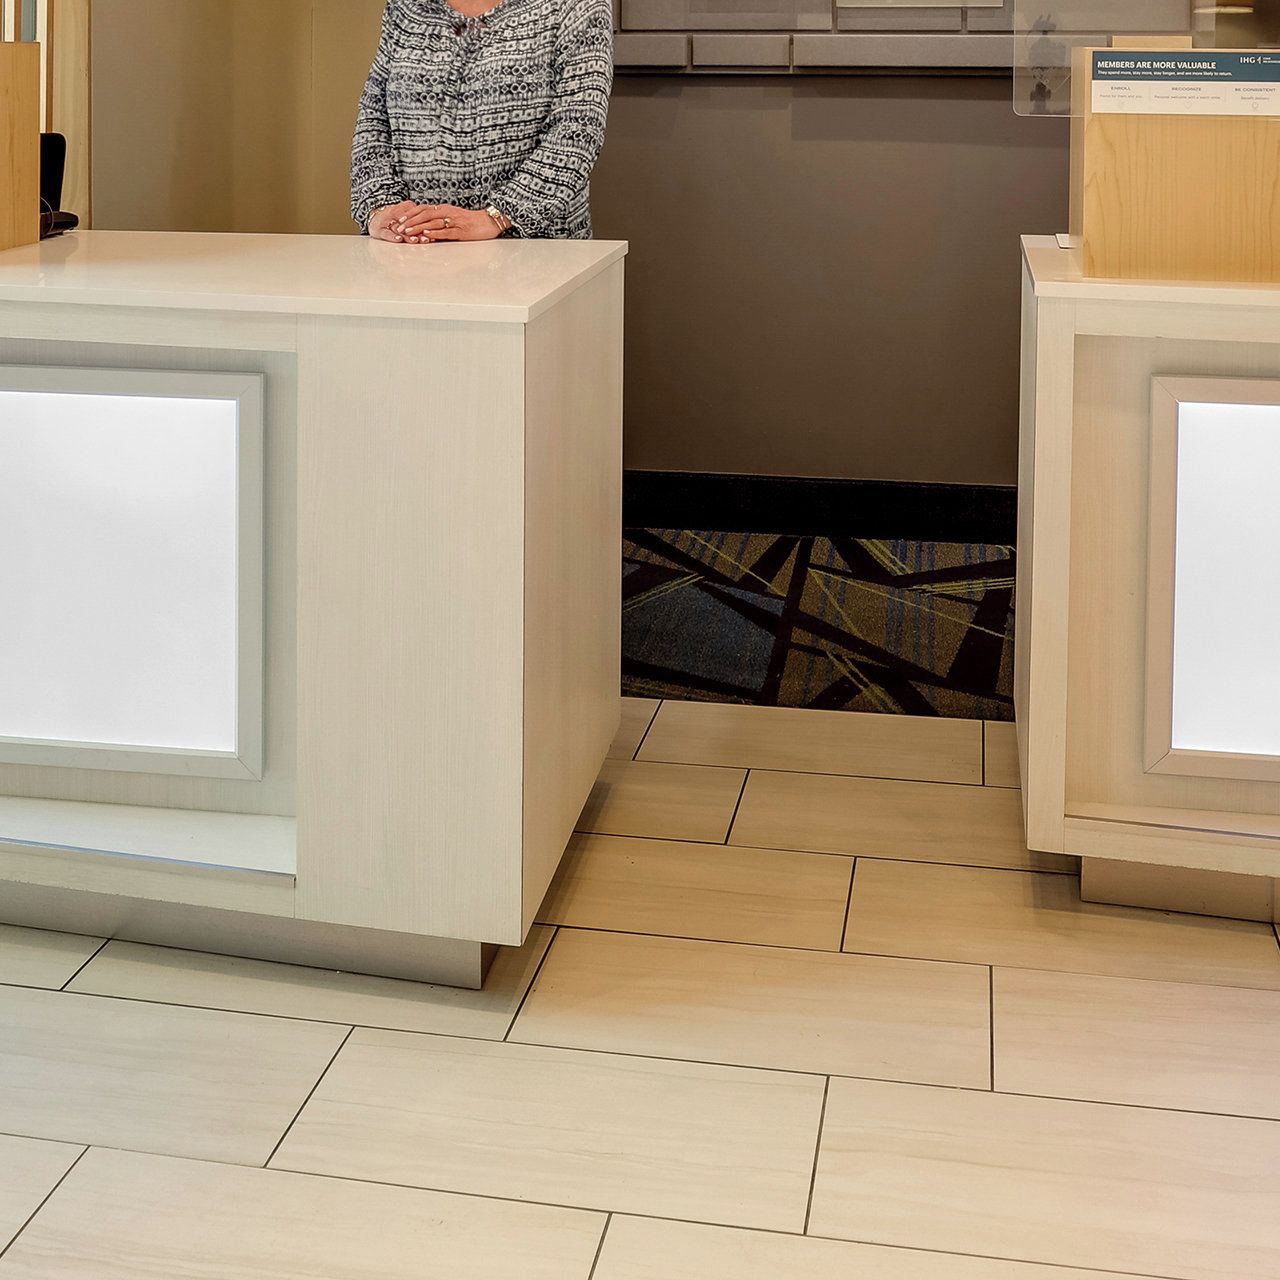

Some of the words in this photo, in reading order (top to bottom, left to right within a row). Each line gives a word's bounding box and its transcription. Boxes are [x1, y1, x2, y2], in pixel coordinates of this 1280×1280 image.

[1136, 61, 1152, 69] ARE
[1152, 61, 1176, 69] MORE
[1177, 61, 1217, 69] VALUABLE
